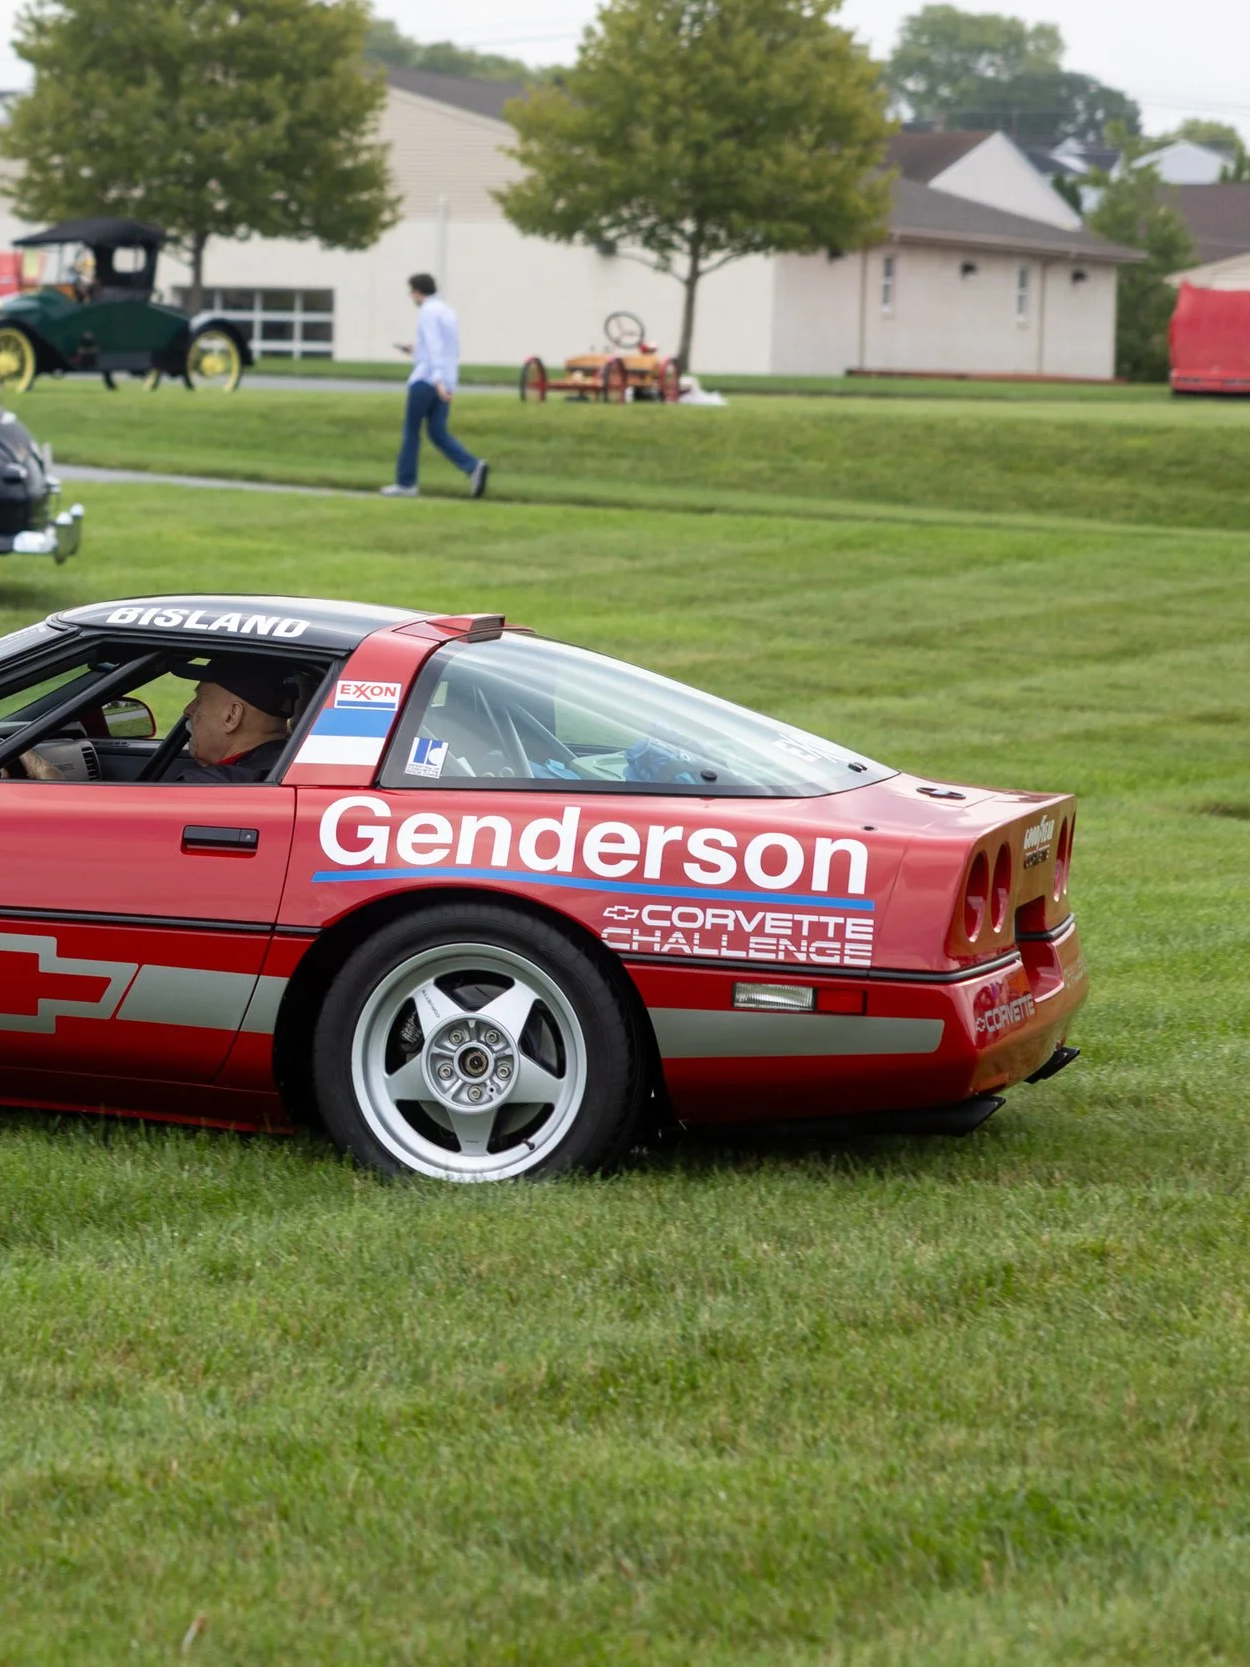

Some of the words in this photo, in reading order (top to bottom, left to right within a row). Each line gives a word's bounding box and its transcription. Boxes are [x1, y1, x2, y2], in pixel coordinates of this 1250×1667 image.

[105, 607, 311, 638] BISLAND
[340, 683, 397, 700] EXXON
[319, 795, 869, 895] Genderson
[641, 904, 875, 941] CORVETTE
[600, 926, 873, 967] CHALLENGE
[984, 993, 1036, 1033] CORVETTE
